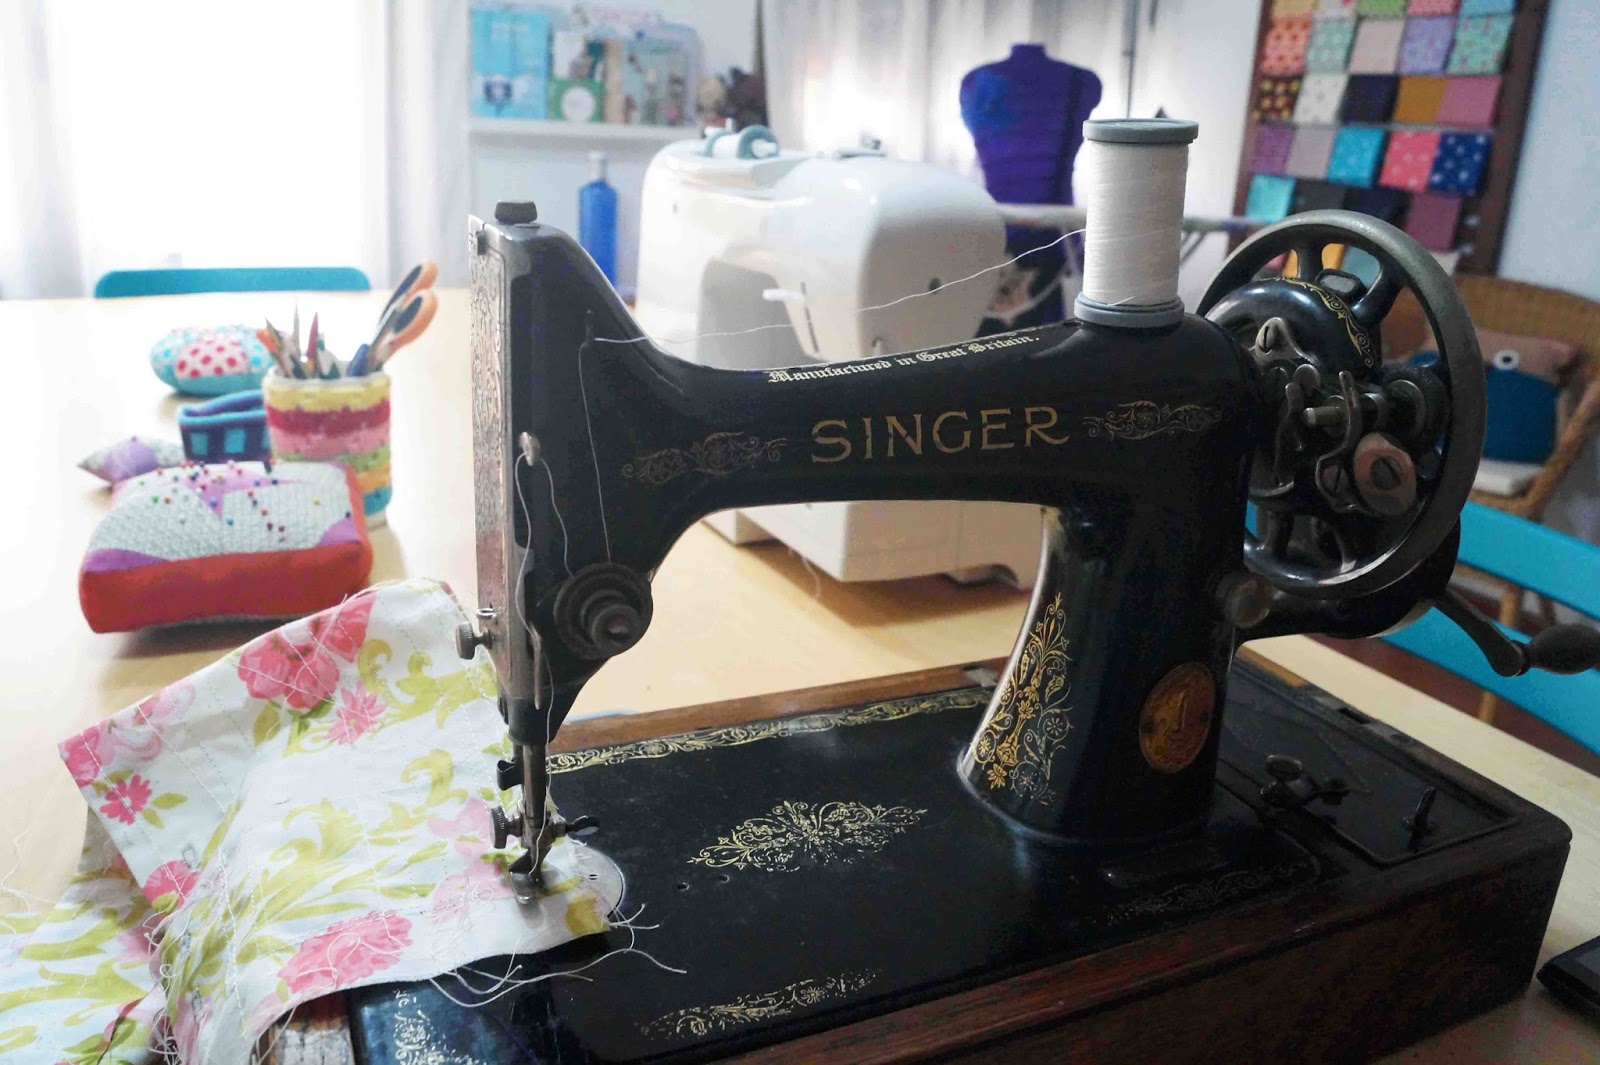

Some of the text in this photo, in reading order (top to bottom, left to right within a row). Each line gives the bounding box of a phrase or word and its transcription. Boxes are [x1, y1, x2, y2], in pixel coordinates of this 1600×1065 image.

[764, 336, 1040, 383] Manufactured in Great Britain.
[811, 406, 1070, 463] SINGER
